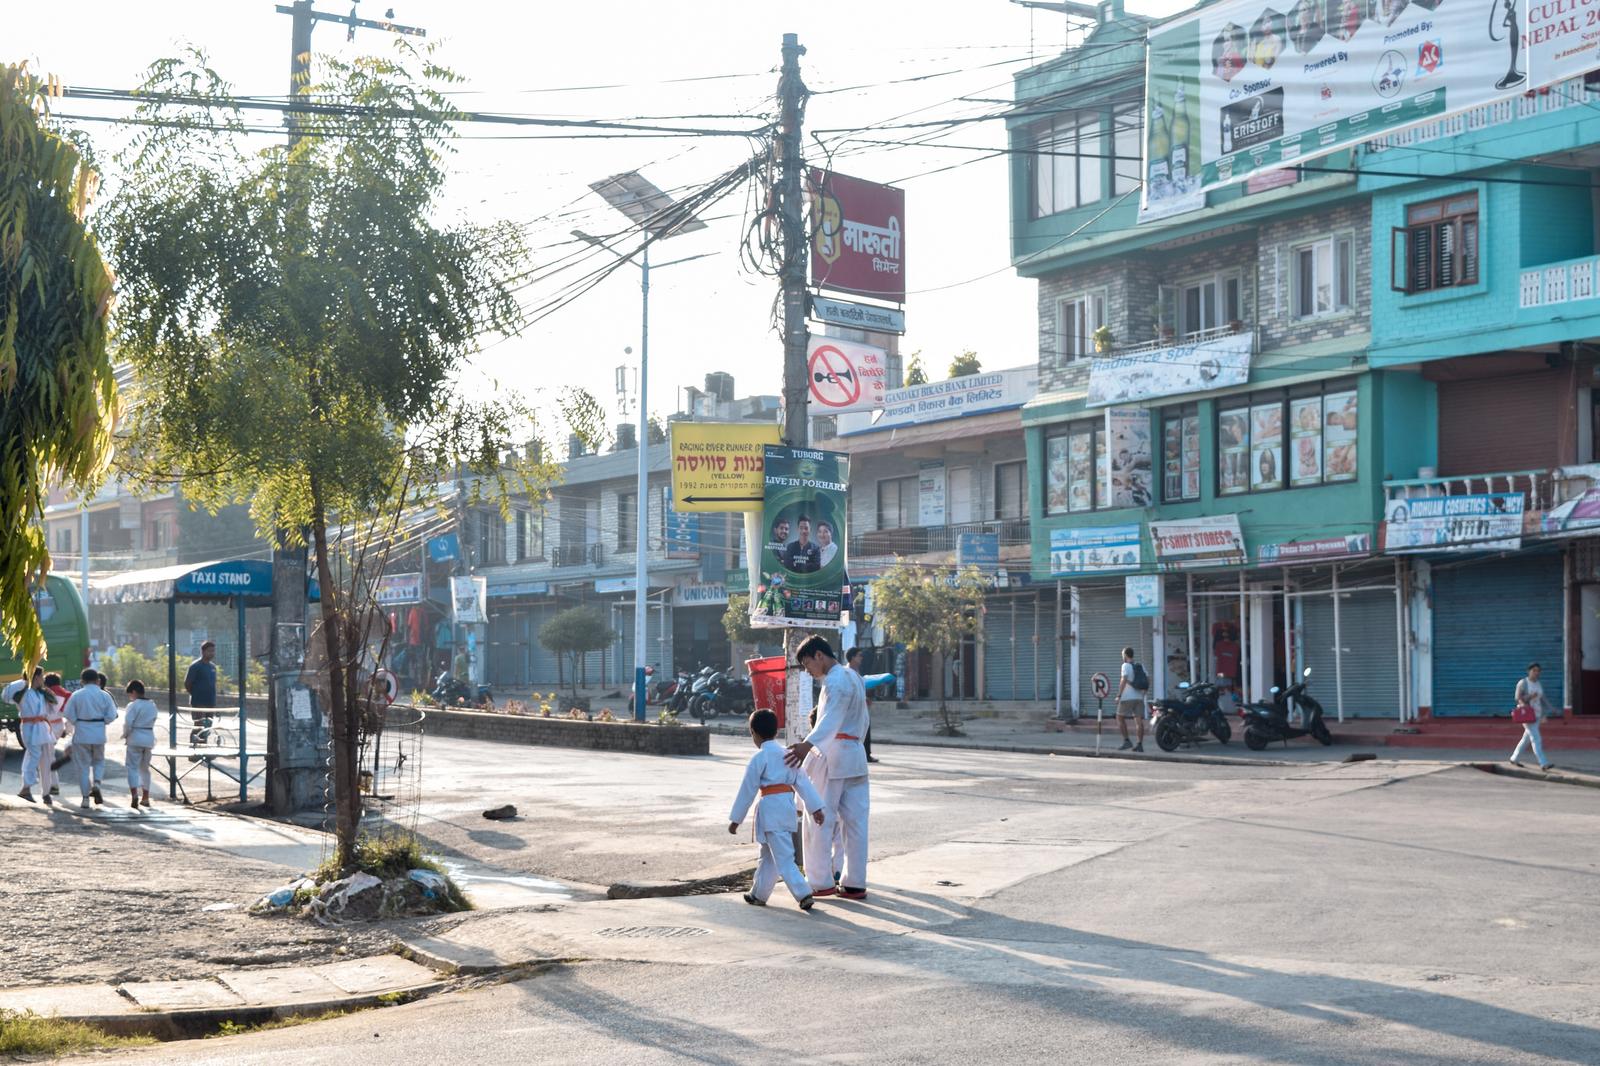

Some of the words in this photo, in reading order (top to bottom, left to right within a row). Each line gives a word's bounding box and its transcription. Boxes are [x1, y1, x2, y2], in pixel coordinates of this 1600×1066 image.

[1383, 23, 1419, 45] Promoted
[1521, 16, 1580, 49] NEPAL
[1303, 54, 1338, 74] Powered
[1339, 51, 1348, 62] By
[1243, 78, 1271, 96] Sponsor
[1233, 113, 1279, 139] ERISTOFF
[885, 390, 920, 403] GANDAKI
[921, 385, 943, 398] BIKAS
[945, 381, 966, 394] BANK
[969, 374, 1003, 390] LIMITED
[918, 398, 945, 412] विकास
[966, 389, 1002, 404] लिमिटेड
[680, 443, 704, 451] RAGING
[706, 443, 725, 451] RIVER
[726, 443, 752, 451] RUNNER
[792, 449, 824, 460] TUBORG
[677, 455, 726, 472] סוויסה
[765, 476, 787, 486] LIVE
[789, 477, 800, 486] IN
[802, 479, 847, 491] POKHARA
[1445, 497, 1487, 516] COSMETICS
[1161, 533, 1193, 550] T-SHIRT
[1194, 529, 1225, 547] STORES
[191, 572, 216, 584] TAXI
[218, 572, 251, 585] STAND
[684, 586, 728, 601] UNICORN
